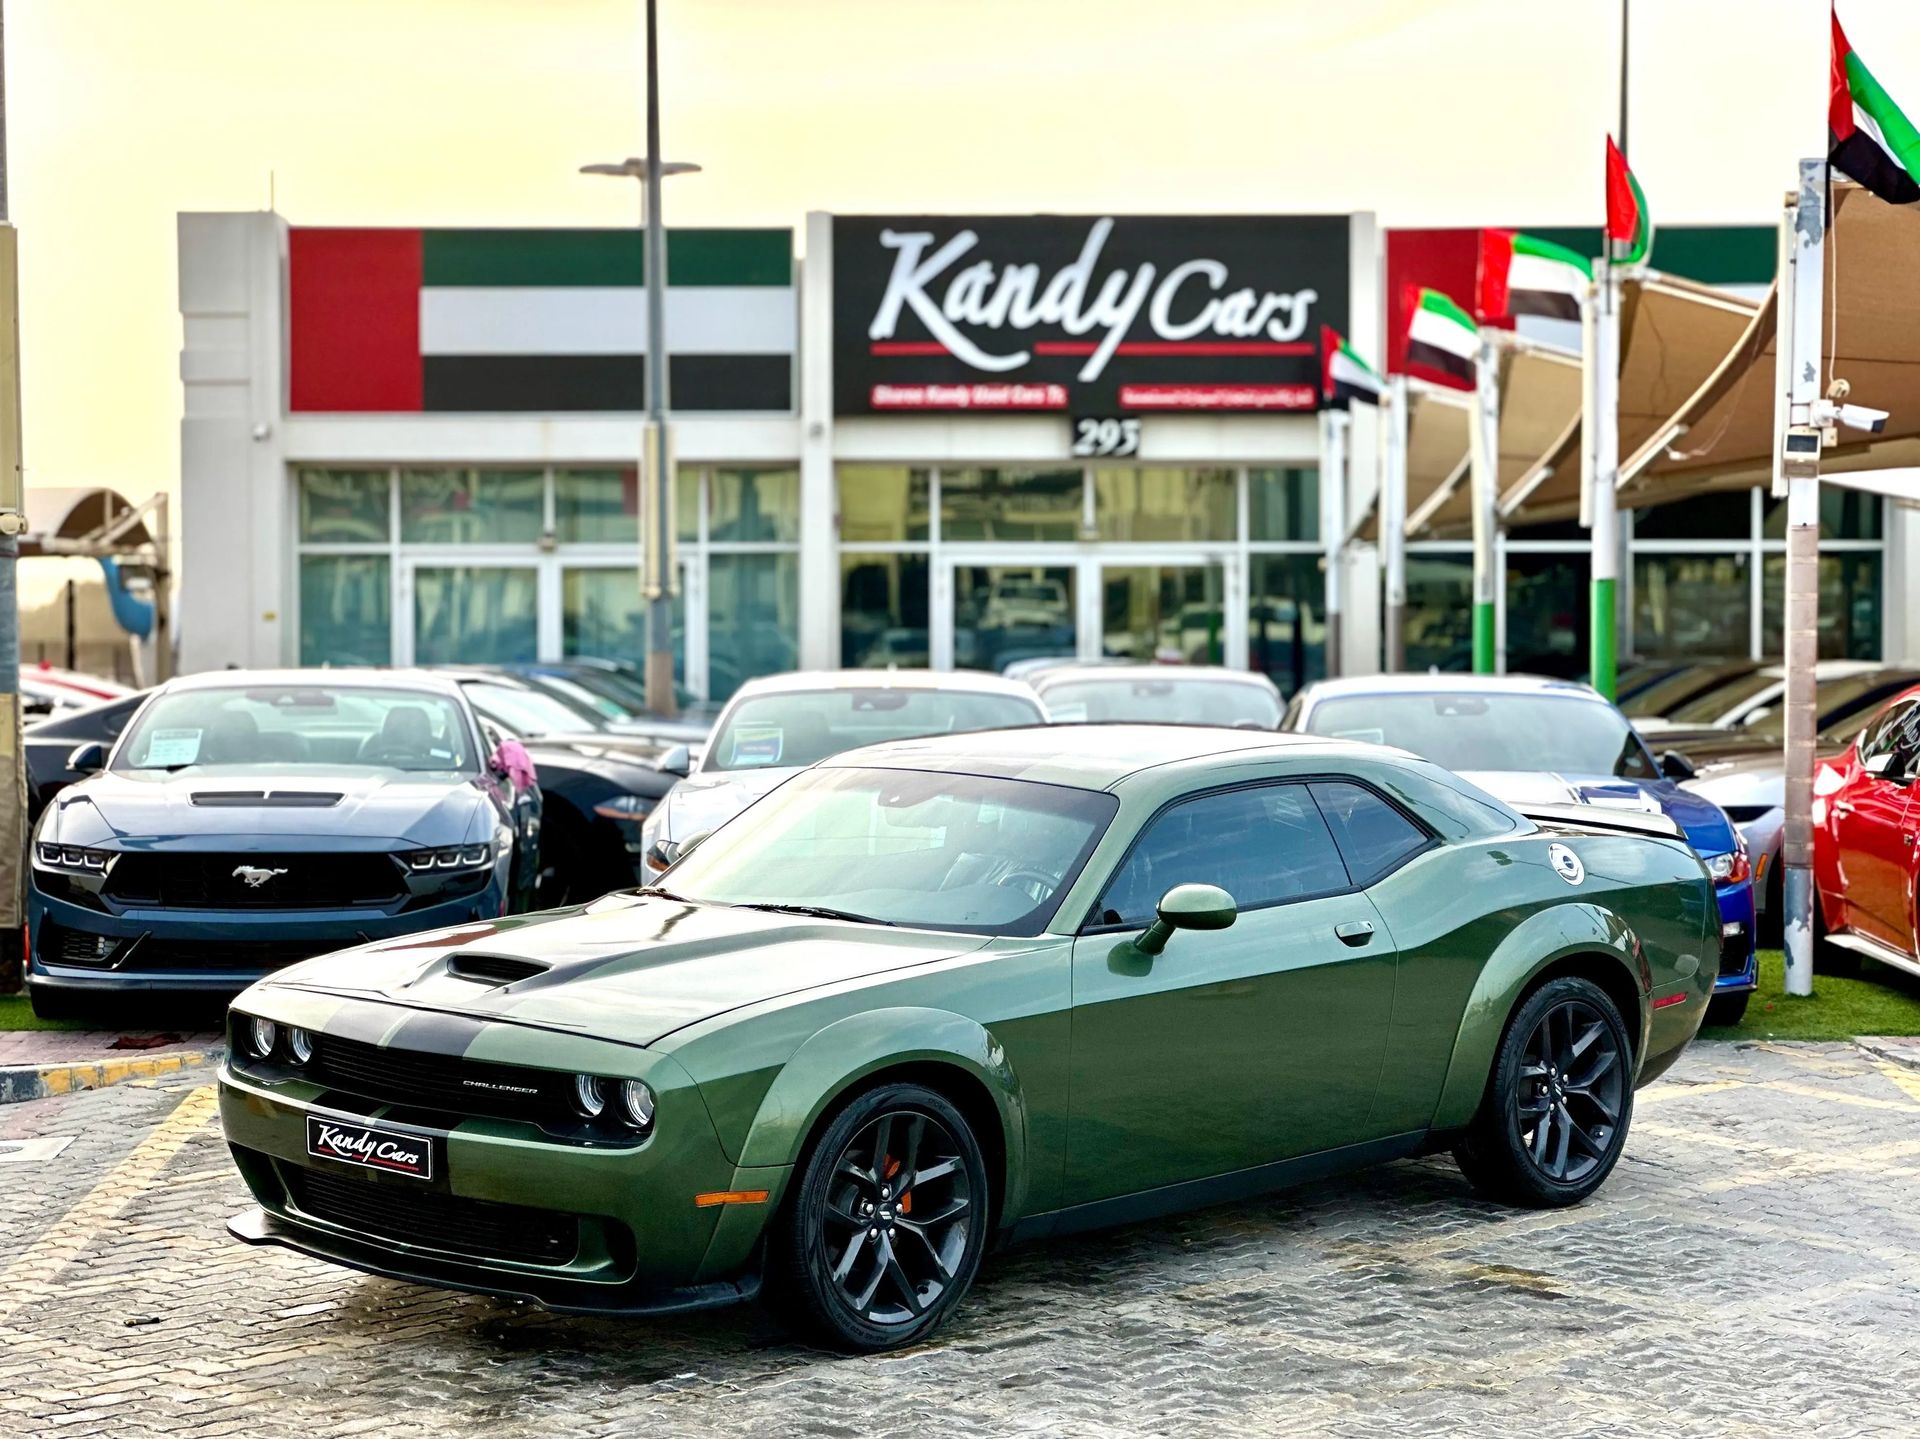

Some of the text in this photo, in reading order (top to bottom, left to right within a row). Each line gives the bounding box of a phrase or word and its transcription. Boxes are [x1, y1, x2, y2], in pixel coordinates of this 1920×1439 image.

[869, 216, 1317, 382] Kandy Cars
[1073, 418, 1141, 455] 295
[463, 1080, 538, 1094] CHALLENGER
[318, 1124, 419, 1164] Kandy Cars
